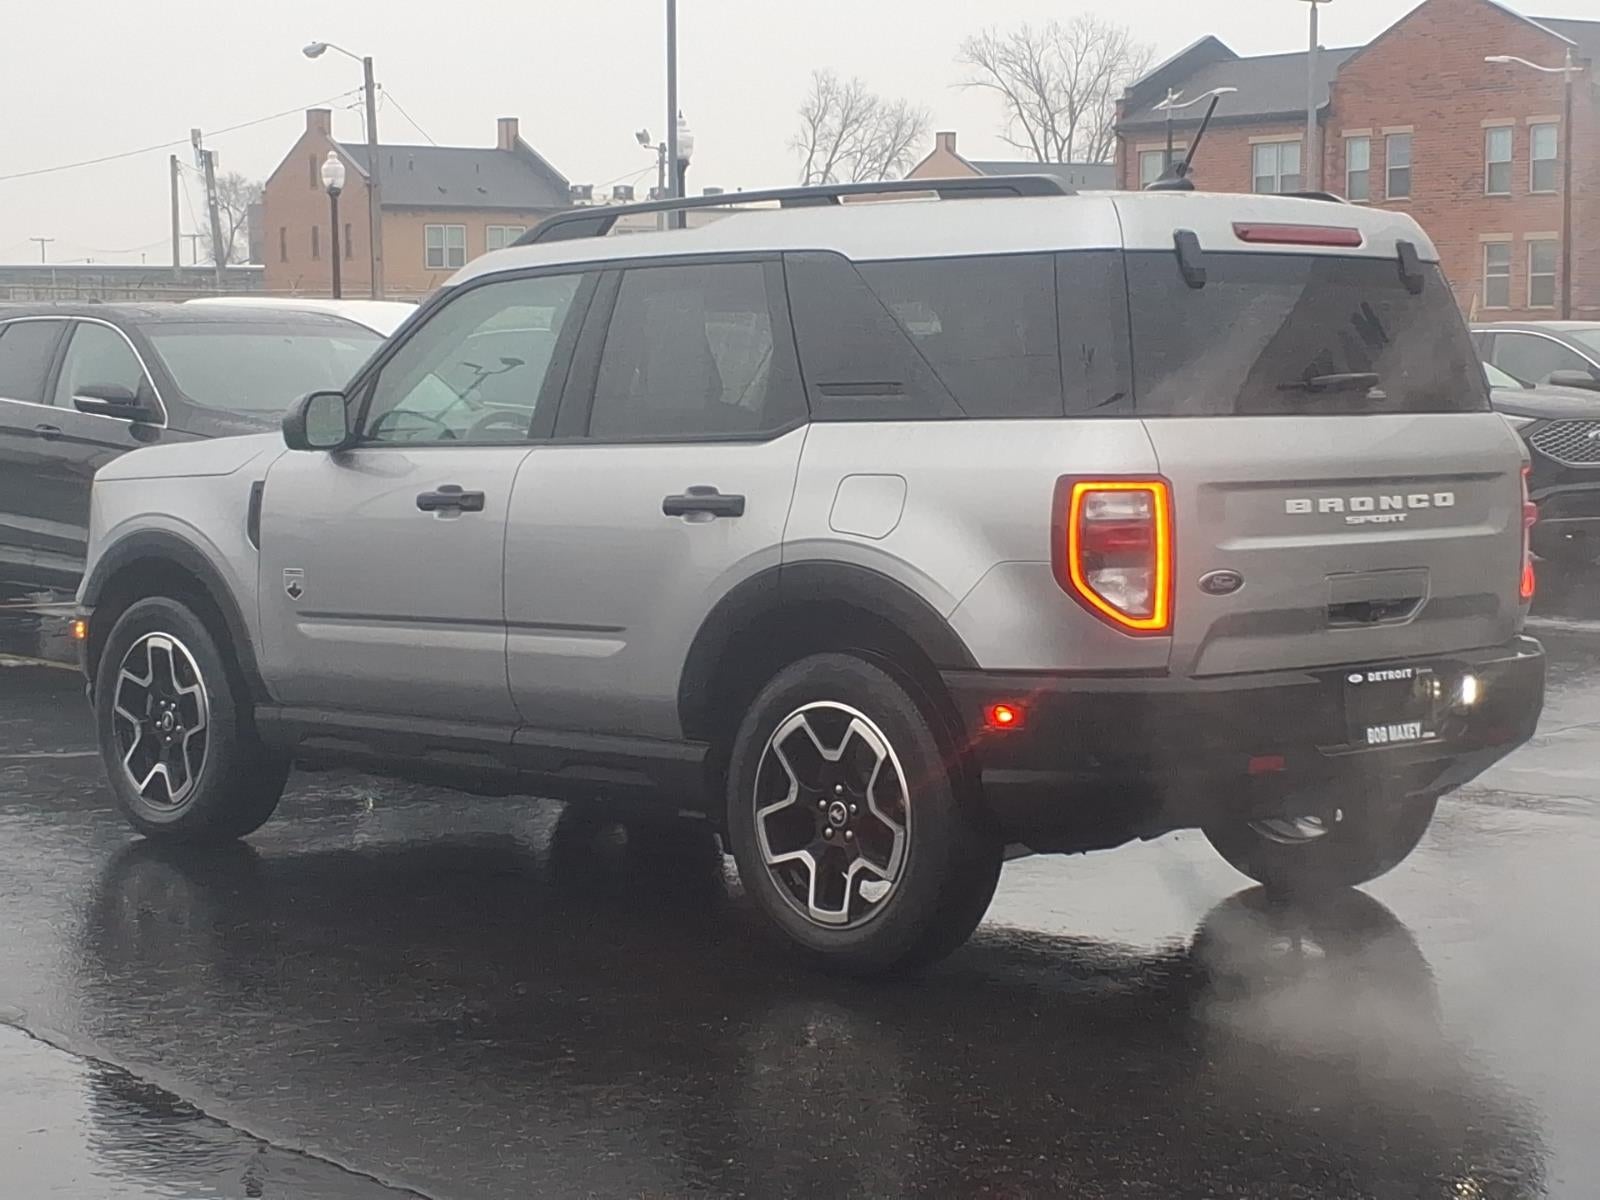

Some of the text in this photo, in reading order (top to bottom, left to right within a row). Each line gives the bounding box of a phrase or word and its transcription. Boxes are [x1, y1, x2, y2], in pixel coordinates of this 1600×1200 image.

[1285, 492, 1455, 513] BRONCO
[1345, 513, 1408, 525] SPORT
[1367, 668, 1412, 682] DETROIT
